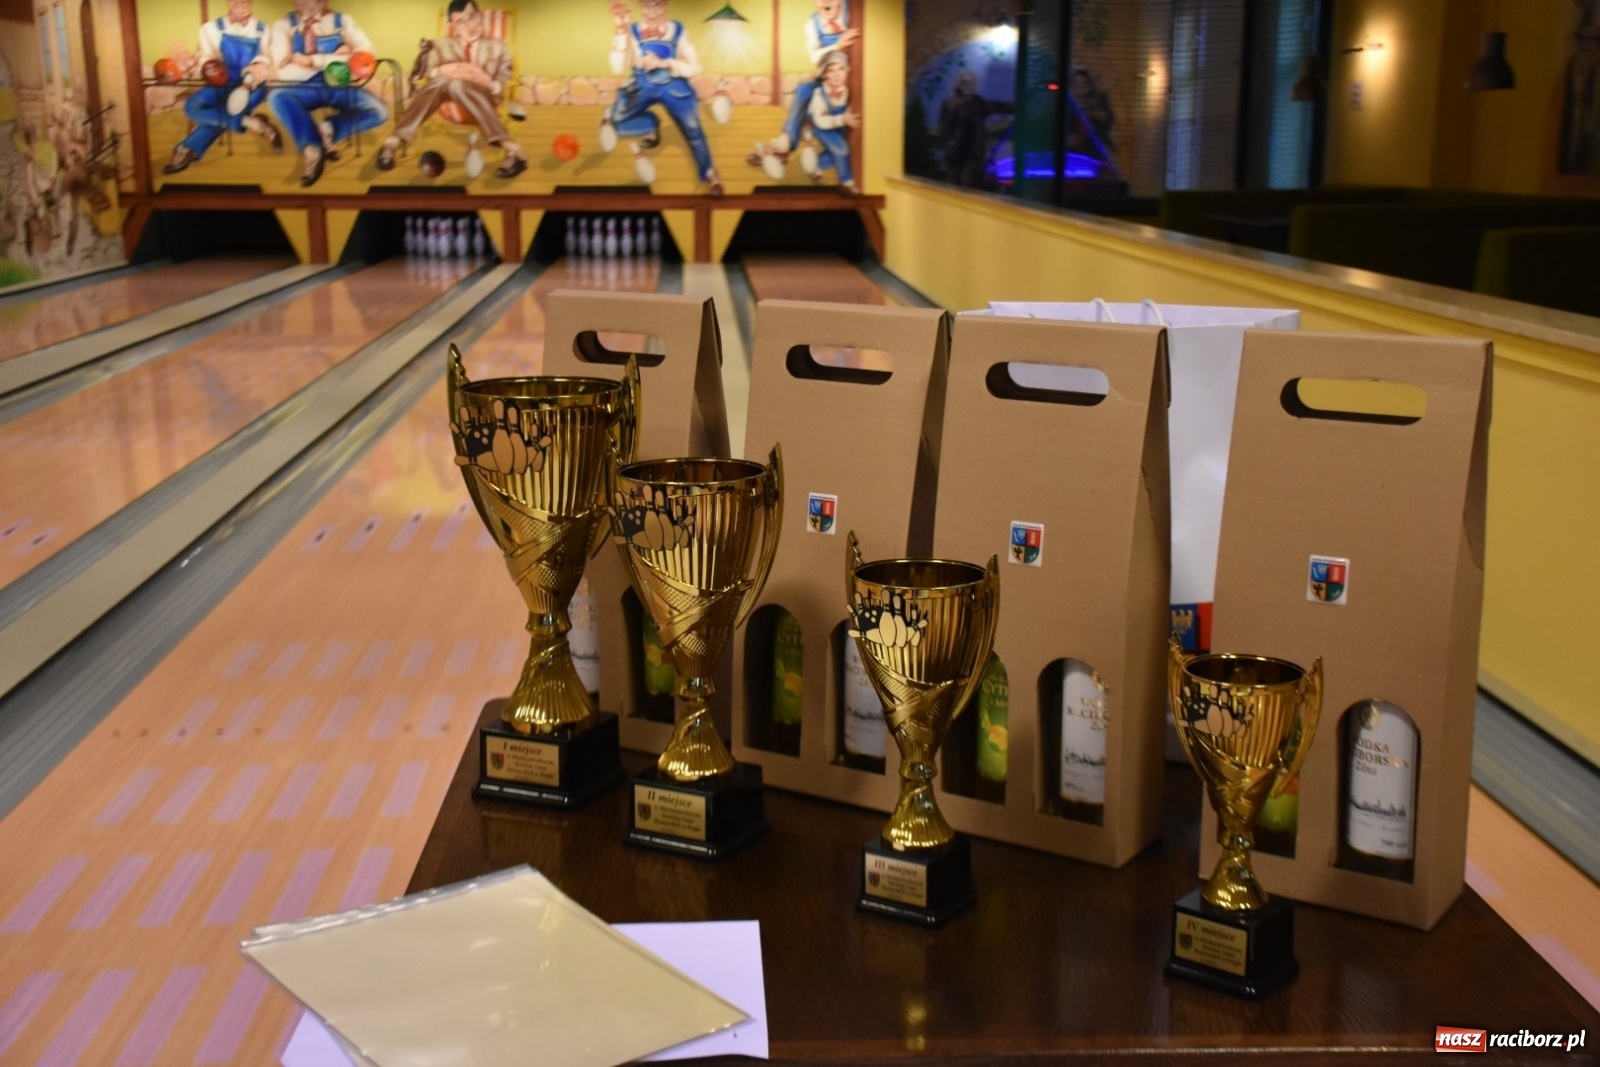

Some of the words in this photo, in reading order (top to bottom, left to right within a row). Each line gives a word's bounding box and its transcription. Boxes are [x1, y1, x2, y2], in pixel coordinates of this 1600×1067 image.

[509, 744, 542, 756] miejsce
[648, 790, 656, 801] II
[658, 793, 693, 808] miejsce
[874, 859, 886, 870] III
